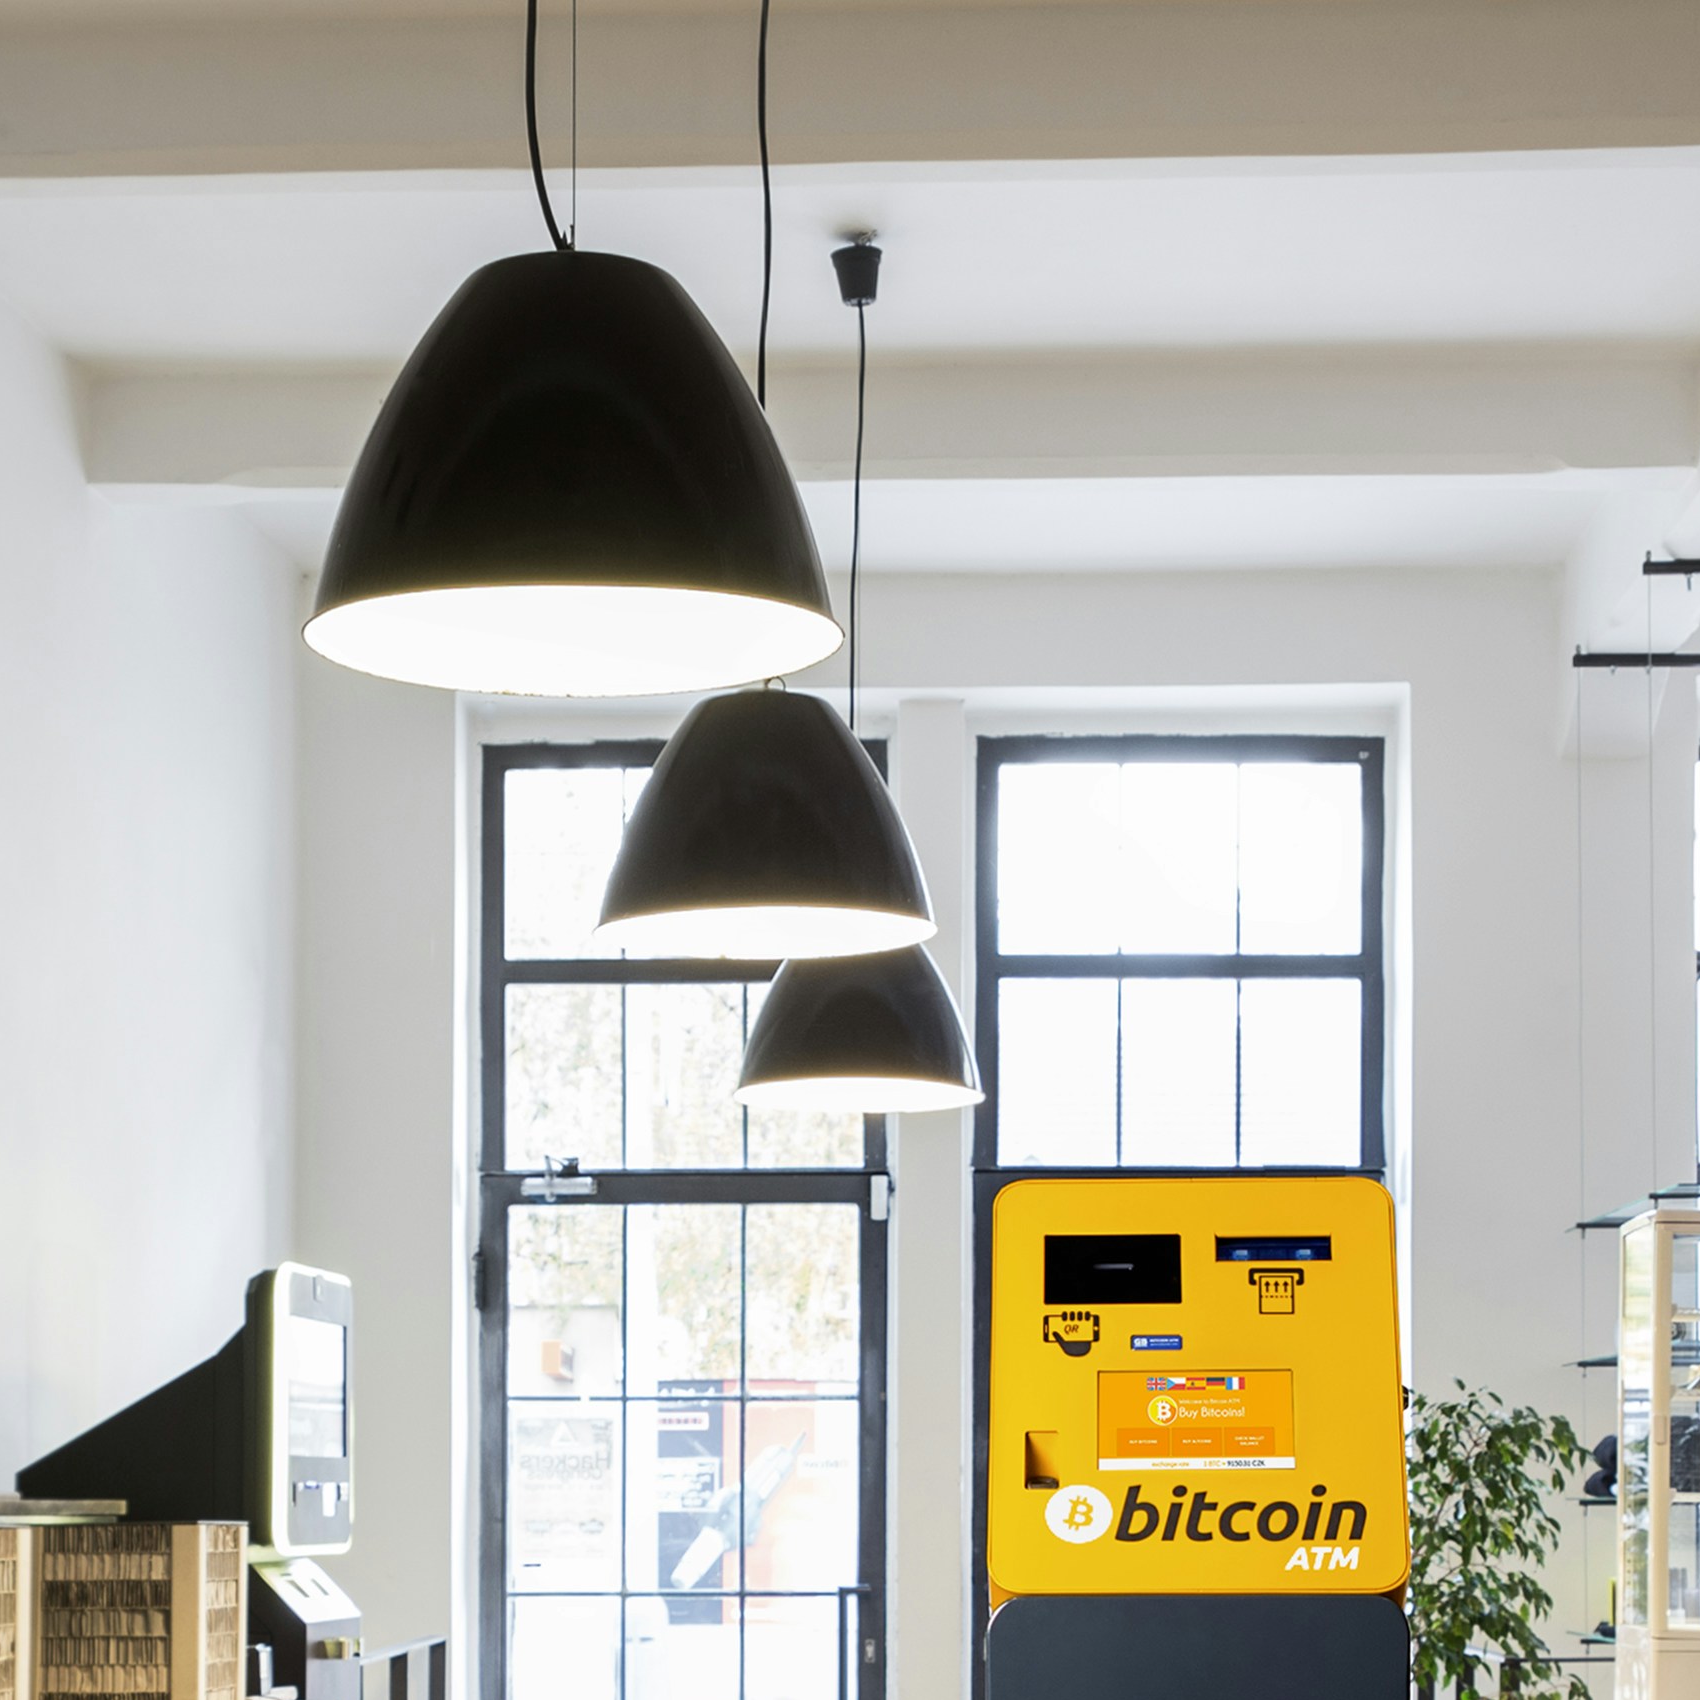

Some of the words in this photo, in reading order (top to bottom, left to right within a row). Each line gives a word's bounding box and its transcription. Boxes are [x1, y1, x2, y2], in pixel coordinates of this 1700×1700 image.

[1064, 1324, 1079, 1335] QR
[1179, 1406, 1198, 1419] Buy
[1201, 1406, 1245, 1418] Bitcoins!
[1114, 1484, 1368, 1542] bitcoin
[1284, 1546, 1360, 1571] ATM
